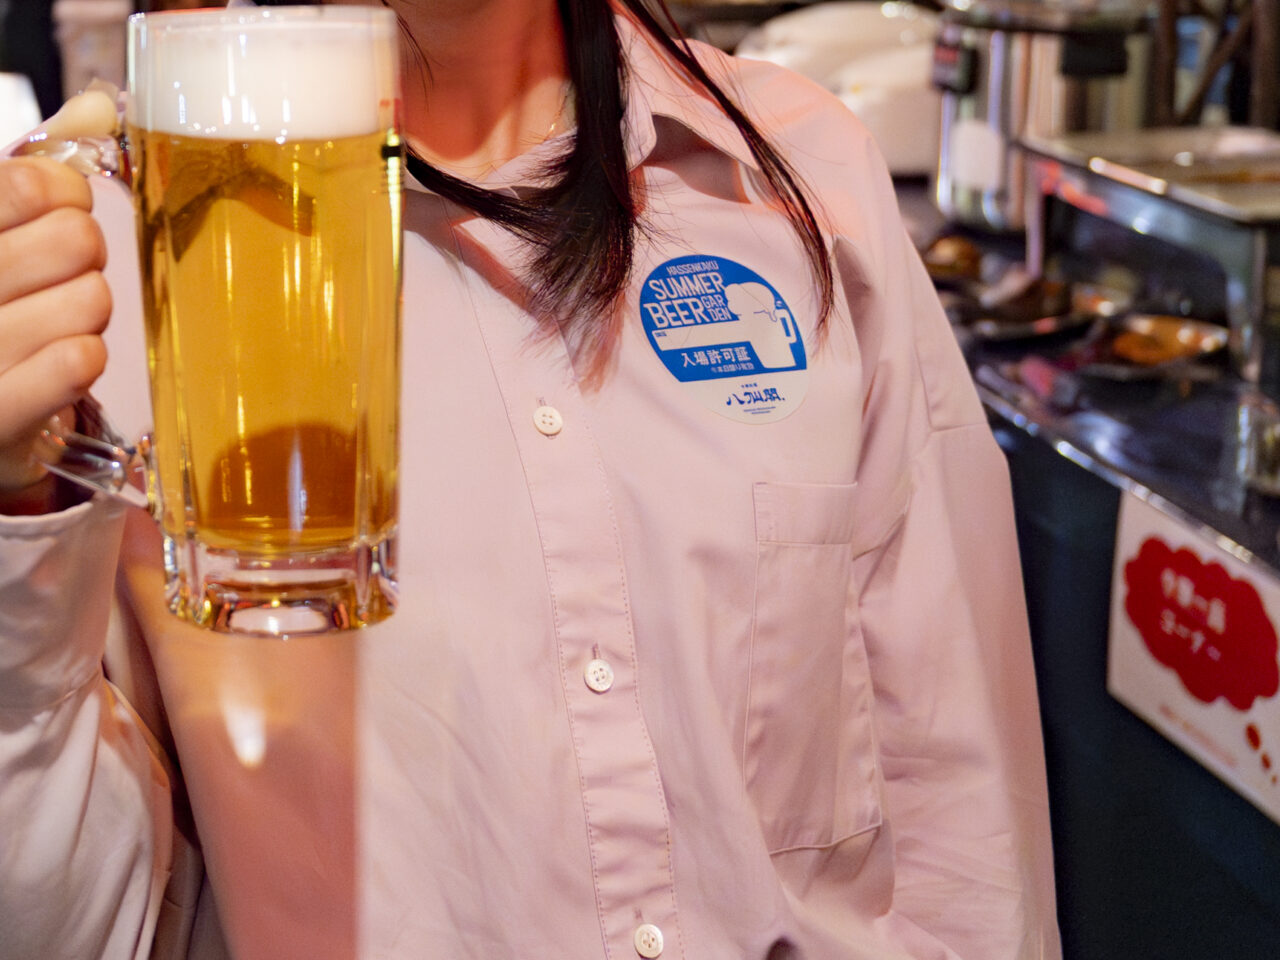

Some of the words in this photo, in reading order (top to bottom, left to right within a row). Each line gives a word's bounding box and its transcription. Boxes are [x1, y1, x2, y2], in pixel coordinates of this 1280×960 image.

[648, 272, 726, 301] SUMMER
[643, 297, 710, 328] BEER
[681, 346, 751, 368] 入場許可証
